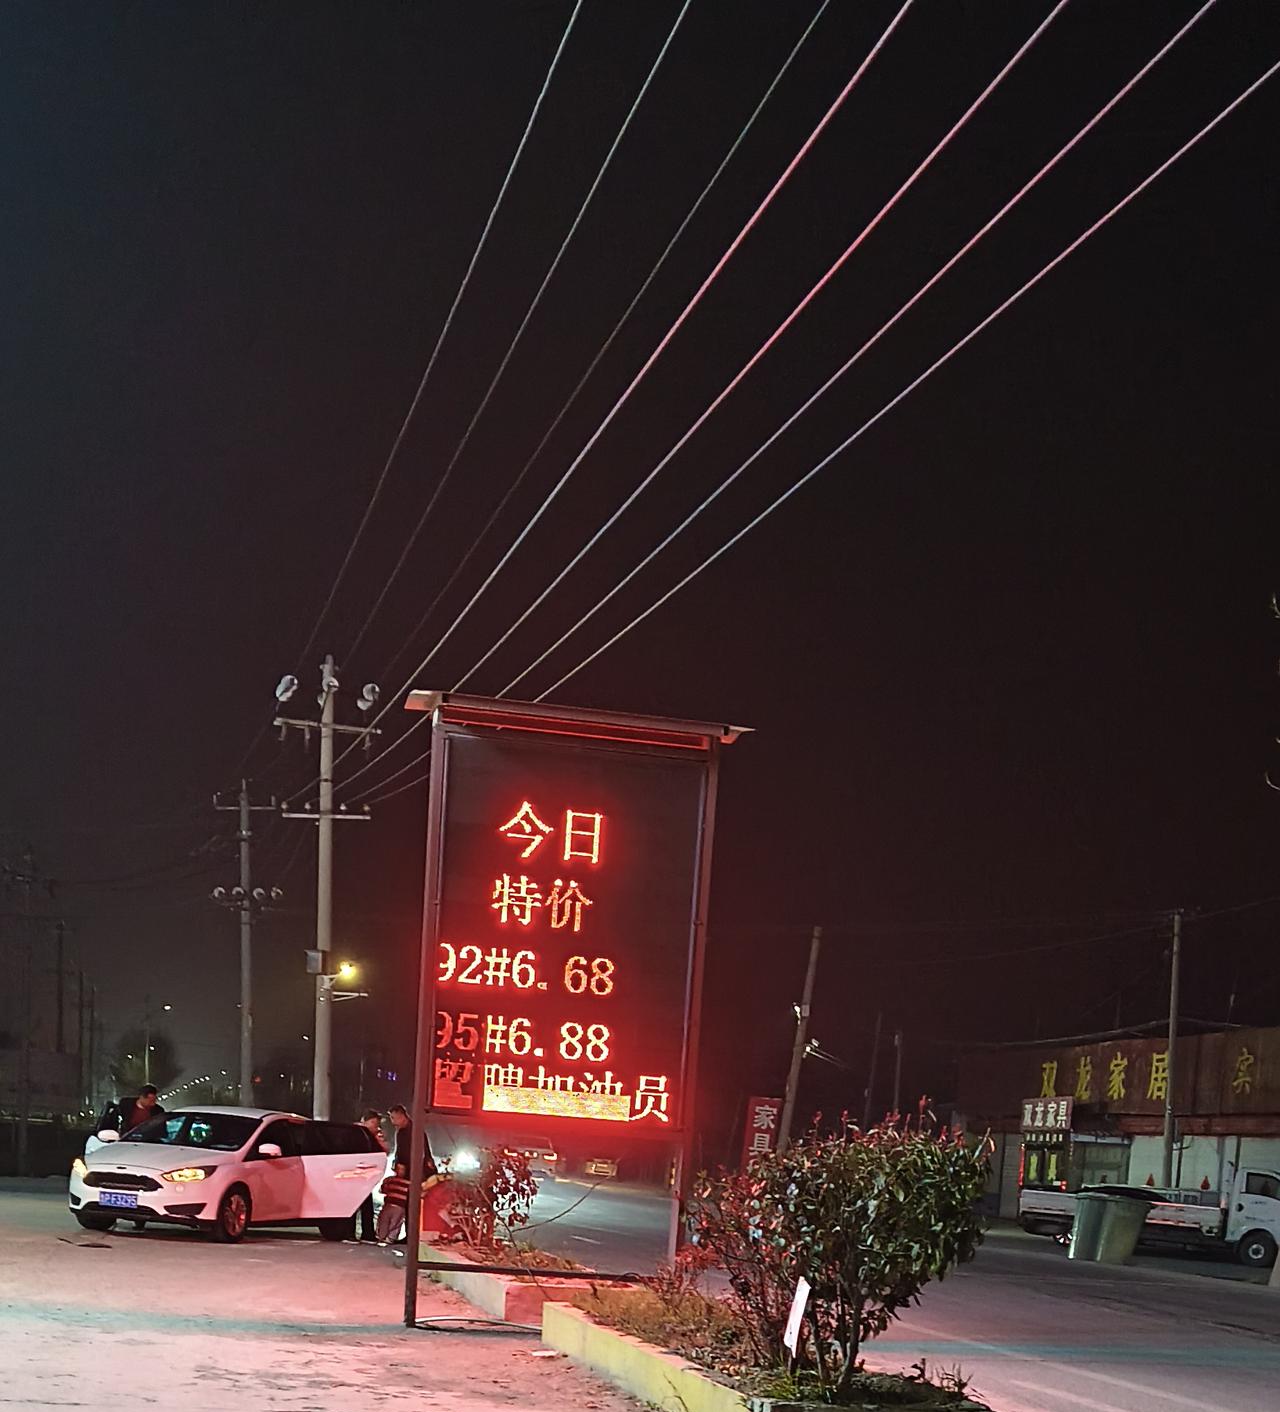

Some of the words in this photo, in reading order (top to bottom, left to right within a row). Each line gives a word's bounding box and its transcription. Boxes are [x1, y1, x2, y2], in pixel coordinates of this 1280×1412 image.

[499, 801, 604, 864] 今日
[491, 873, 593, 932] 特价
[1022, 1100, 1067, 1128] 双龙家具
